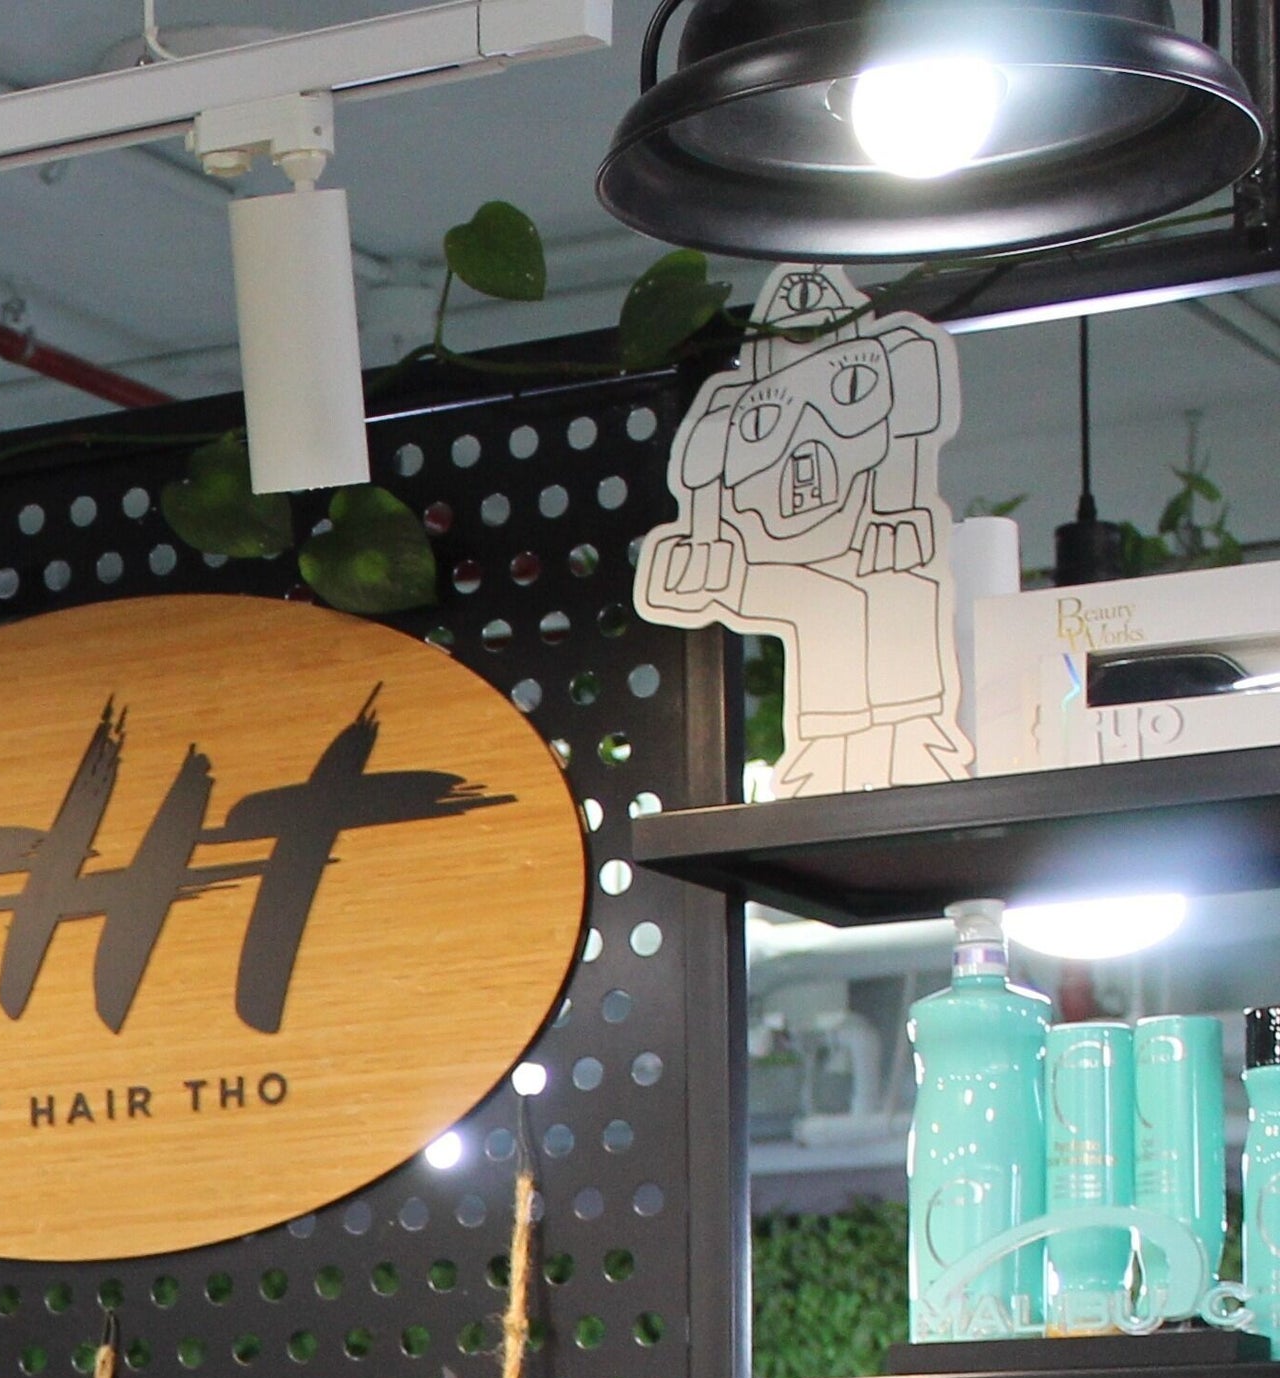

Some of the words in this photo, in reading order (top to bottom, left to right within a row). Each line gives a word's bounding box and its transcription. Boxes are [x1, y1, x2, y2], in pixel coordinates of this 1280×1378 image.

[1057, 597, 1136, 640] Beauty
[1065, 621, 1145, 651] Works
[30, 1086, 152, 1129] HAIR
[184, 1071, 290, 1114] THO
